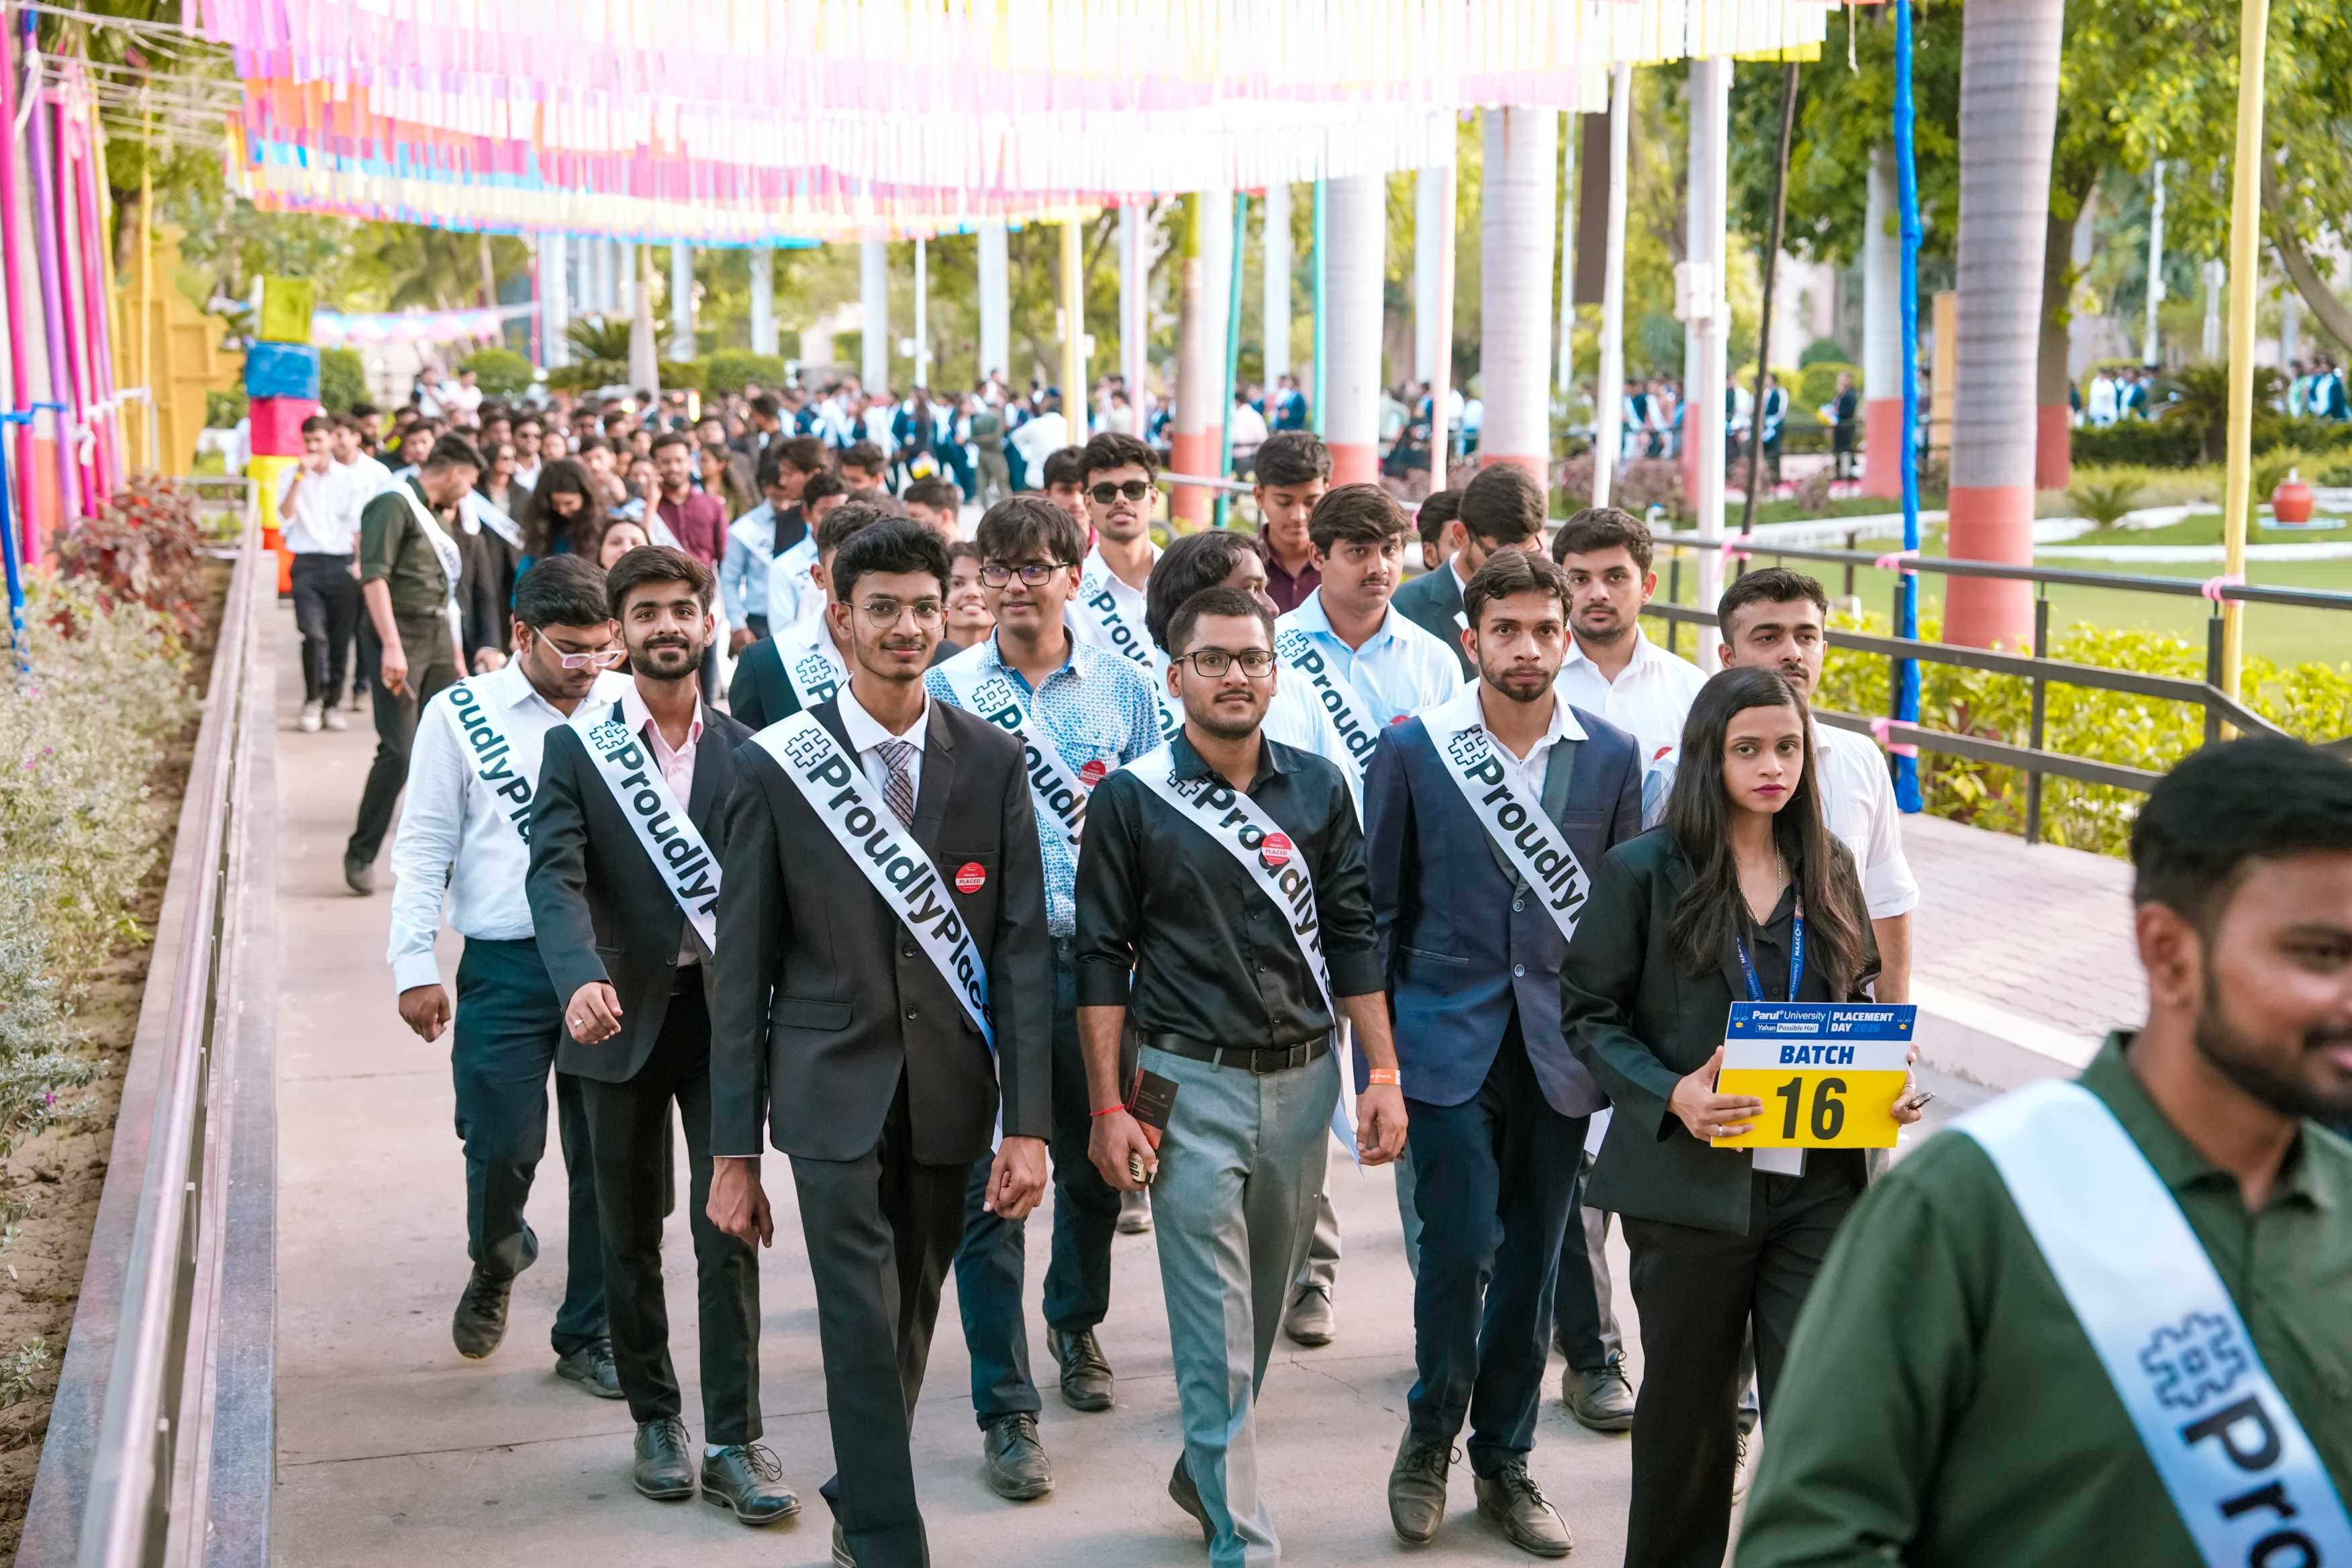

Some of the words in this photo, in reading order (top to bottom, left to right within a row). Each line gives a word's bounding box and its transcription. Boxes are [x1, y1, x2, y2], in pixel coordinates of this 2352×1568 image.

[1275, 628, 1378, 782] #Proudl
[1447, 723, 1586, 924] #Proudly
[1783, 1010, 1826, 1022] University
[1832, 1012, 1894, 1022] PLACEMENT
[1830, 1022, 1853, 1032] DAY
[1779, 1044, 1855, 1065] BATCH
[1776, 1077, 1848, 1140] 16
